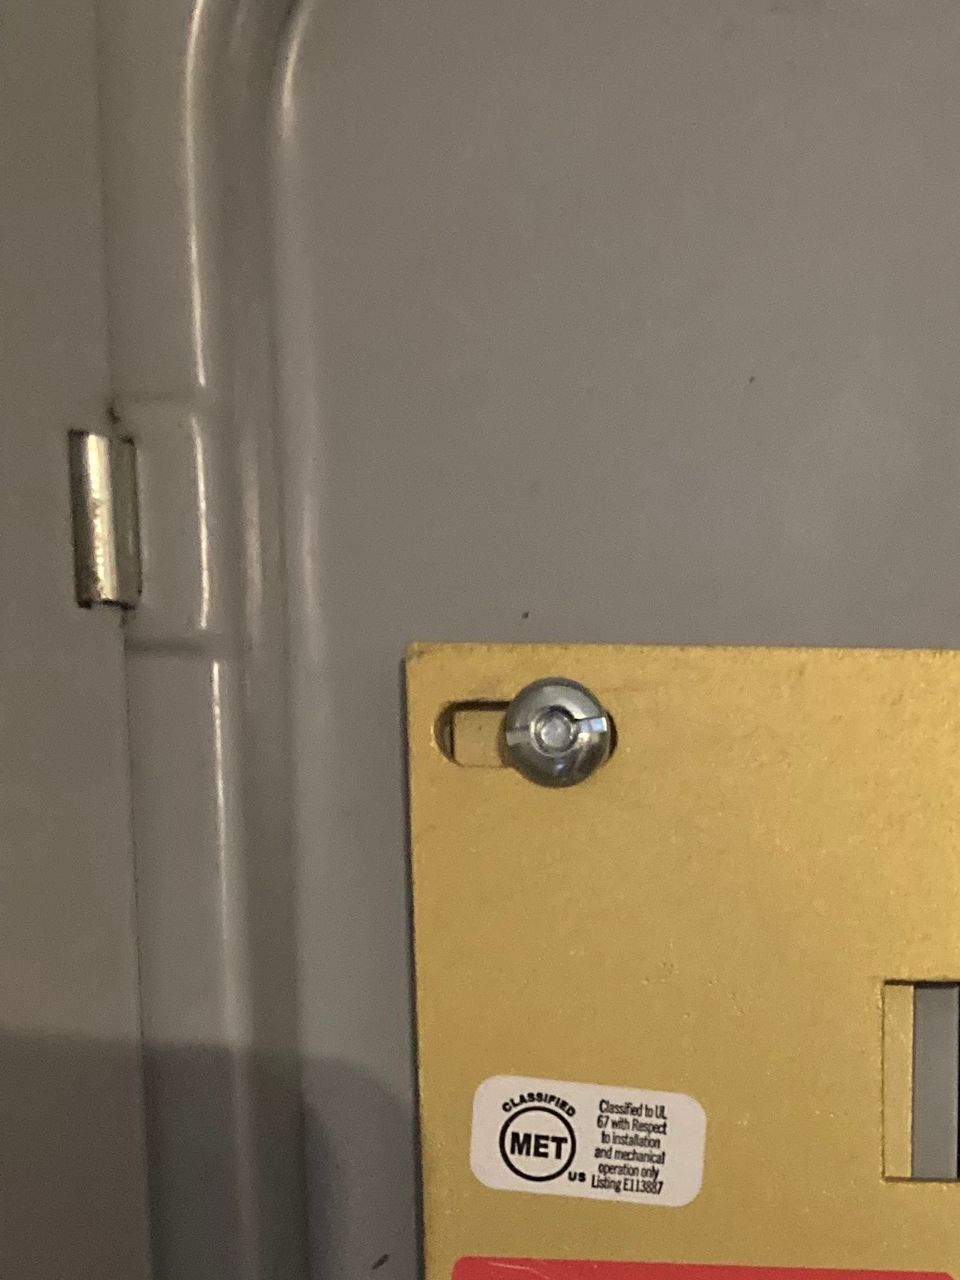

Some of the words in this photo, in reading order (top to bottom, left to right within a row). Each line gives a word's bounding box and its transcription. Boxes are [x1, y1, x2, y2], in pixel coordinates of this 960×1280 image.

[502, 1092, 576, 1118] CLASSIFIED
[599, 1099, 643, 1118] Classified
[645, 1106, 653, 1118] to
[655, 1106, 667, 1120] UL
[597, 1115, 610, 1129] 67
[611, 1116, 630, 1130] with
[631, 1119, 667, 1135] Respect
[510, 1131, 568, 1160] MET
[601, 1131, 611, 1144] to
[612, 1133, 661, 1149] installation
[594, 1147, 613, 1160] and
[614, 1149, 666, 1165] mechanical
[568, 1170, 587, 1183] US
[598, 1162, 640, 1178] operation
[641, 1165, 660, 1181] only
[591, 1174, 622, 1193] Listing
